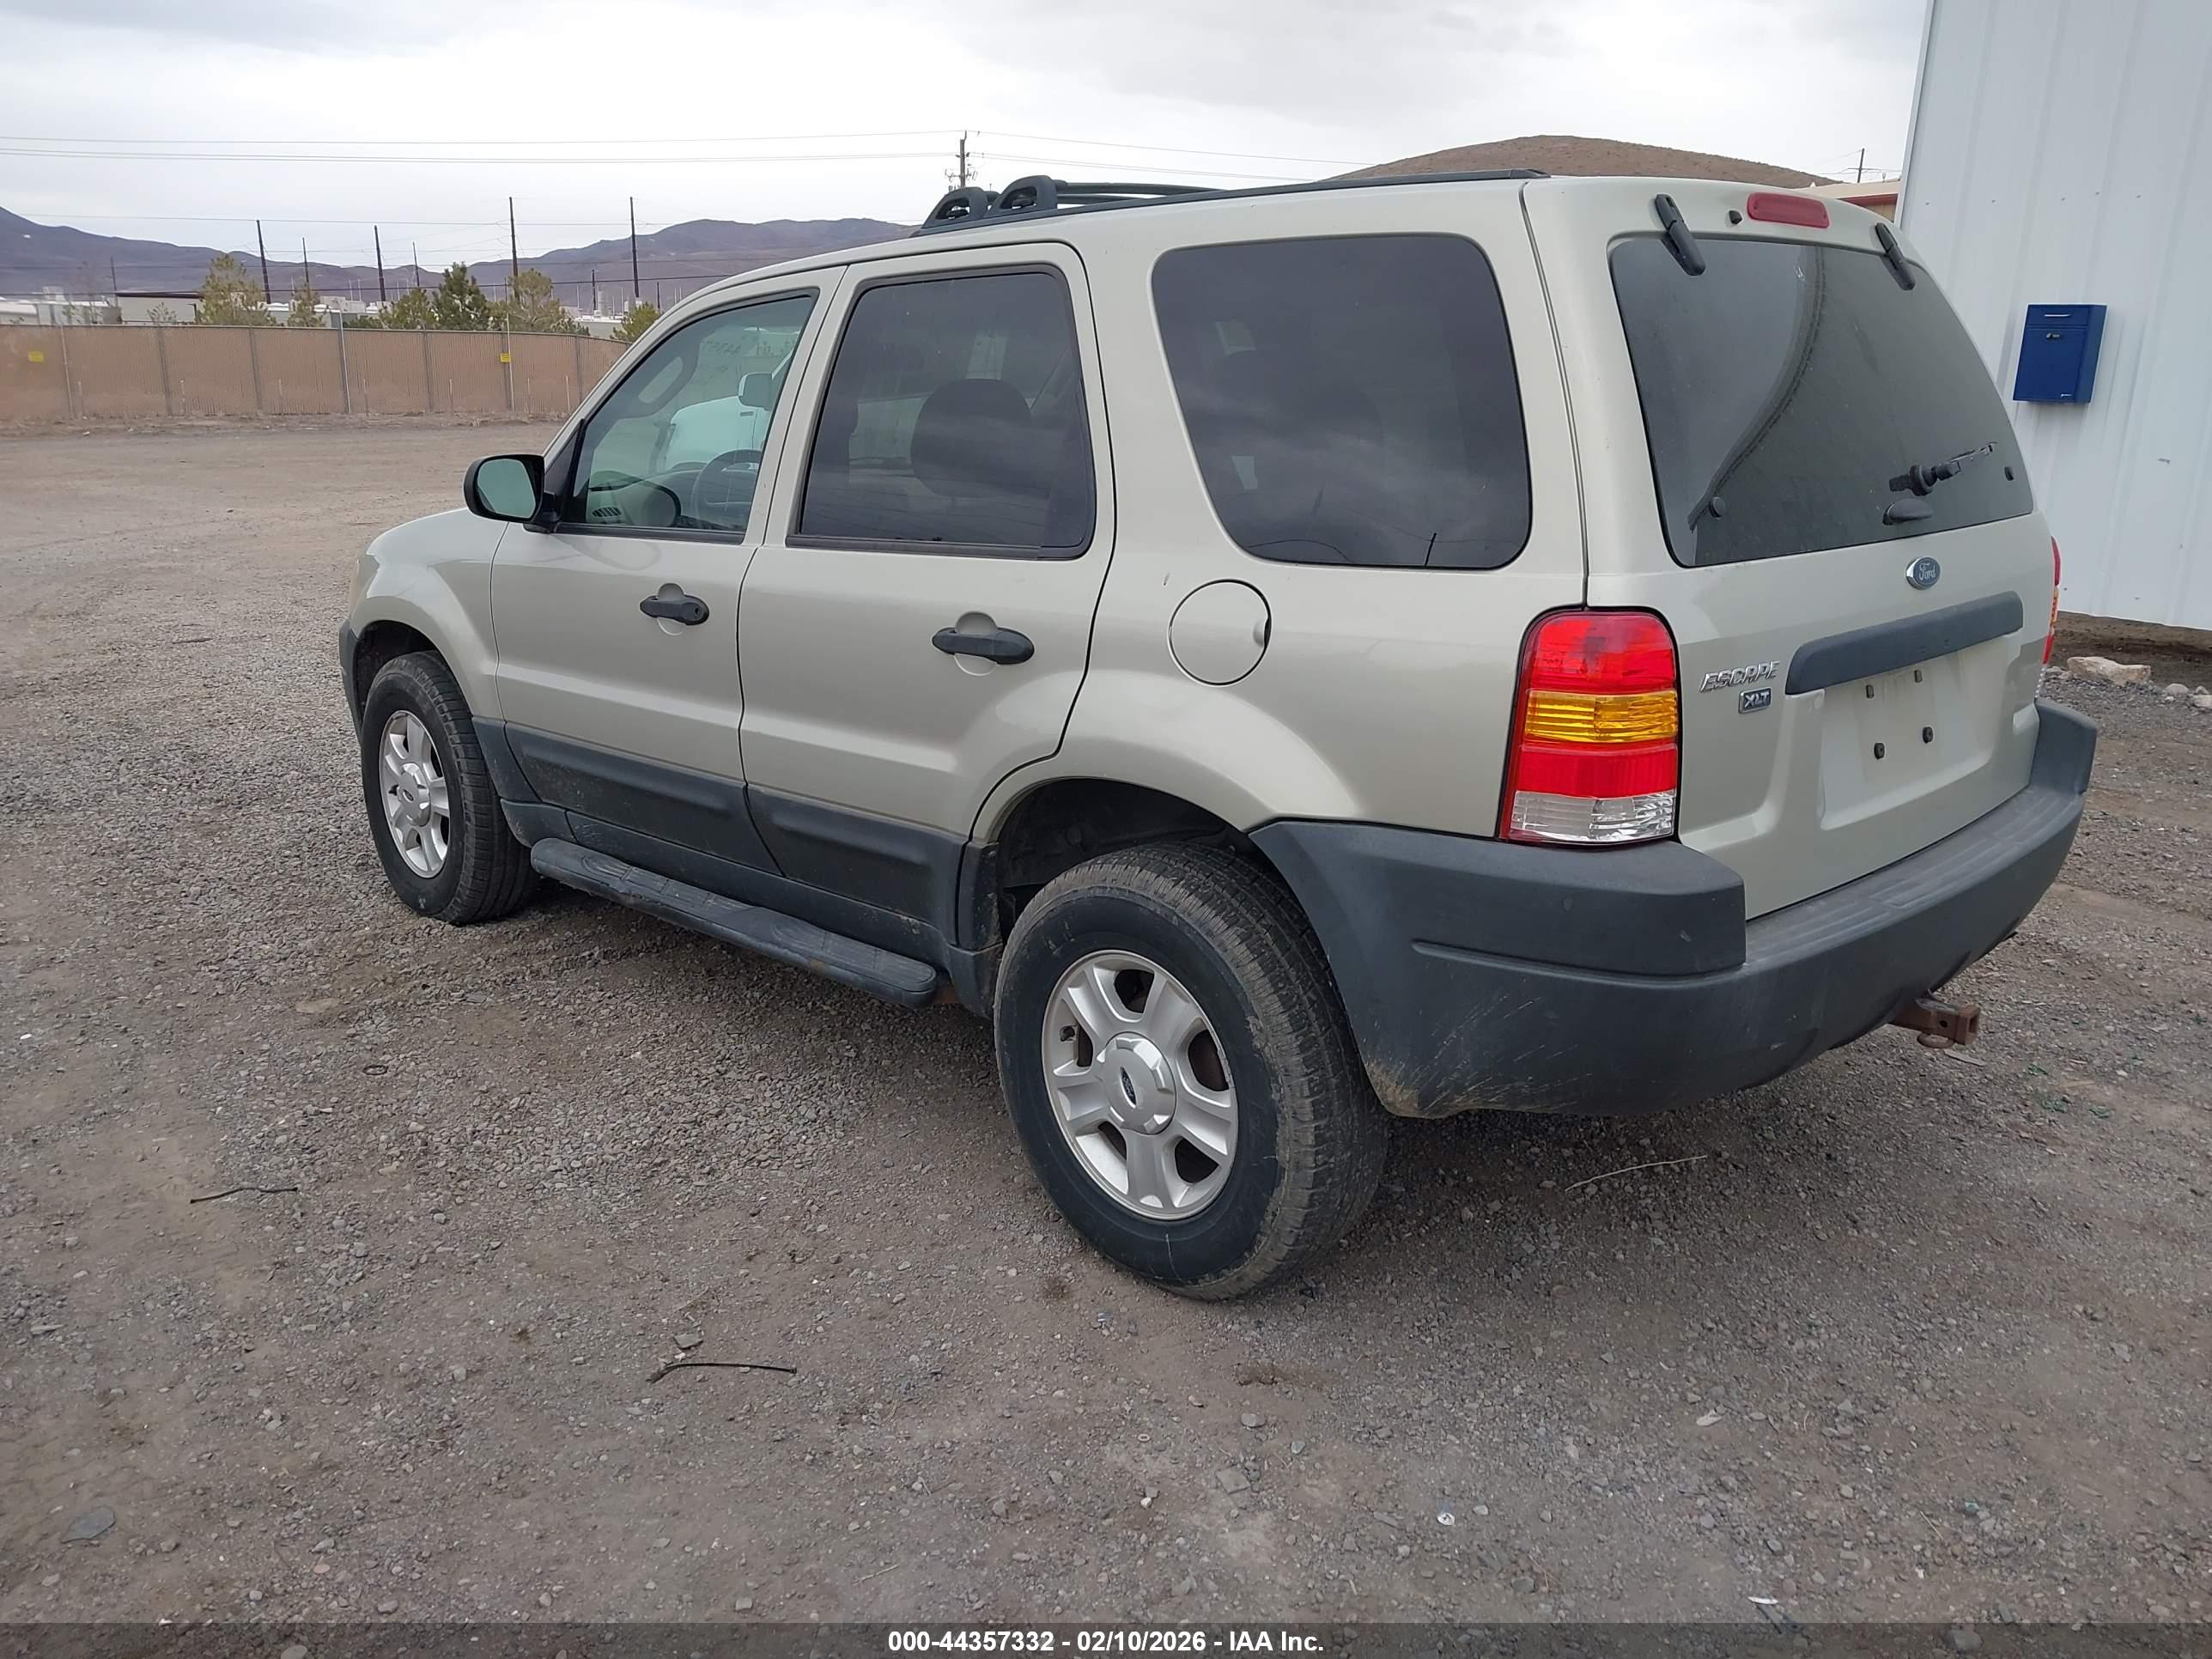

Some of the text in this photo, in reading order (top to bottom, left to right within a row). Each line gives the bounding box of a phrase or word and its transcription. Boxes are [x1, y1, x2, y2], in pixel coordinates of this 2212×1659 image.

[1918, 562, 1936, 580] Ford
[1699, 660, 1779, 692] ESCAPE
[1744, 690, 1769, 708] XLT
